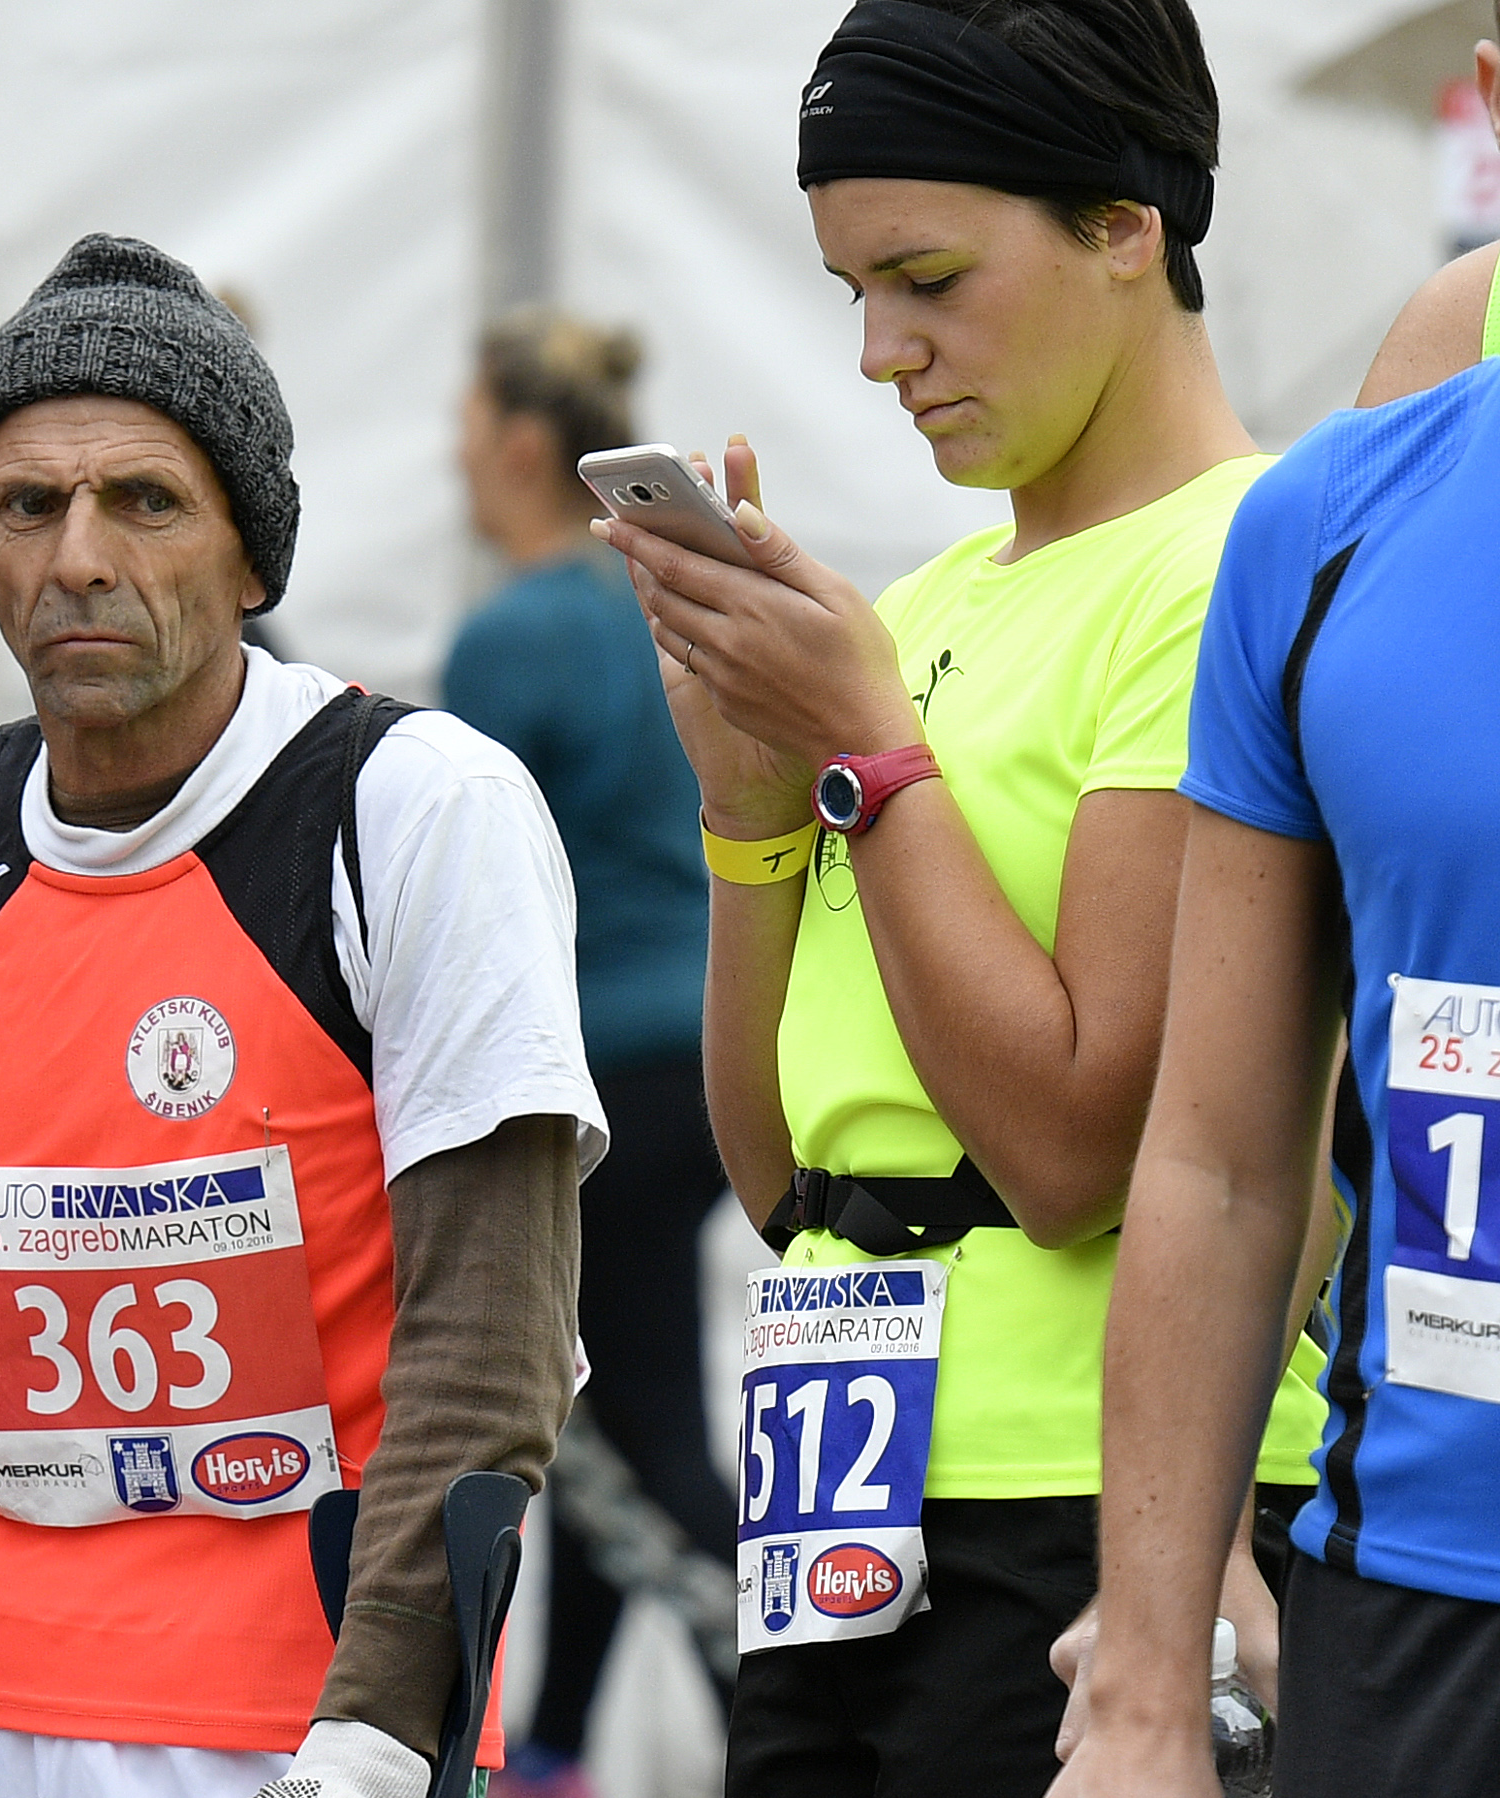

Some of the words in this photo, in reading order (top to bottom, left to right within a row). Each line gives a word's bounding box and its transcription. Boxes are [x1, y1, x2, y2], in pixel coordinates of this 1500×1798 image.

[131, 1001, 195, 1056] ATLETSKI
[198, 1006, 230, 1049] KLUB
[1422, 995, 1500, 1036] AUT
[1419, 1034, 1472, 1073] 25.
[145, 1090, 217, 1117] ŠIBENIK
[1427, 1112, 1485, 1261] 1
[213, 1234, 274, 1253] 09.10.2016
[746, 1272, 896, 1318] OHRVATSKA
[1408, 1310, 1500, 1338] MERKUR
[13, 1278, 233, 1415] 363
[870, 1342, 920, 1355] 09.10.2016
[204, 1448, 301, 1486] Hervis
[815, 1562, 894, 1600] Hervis
